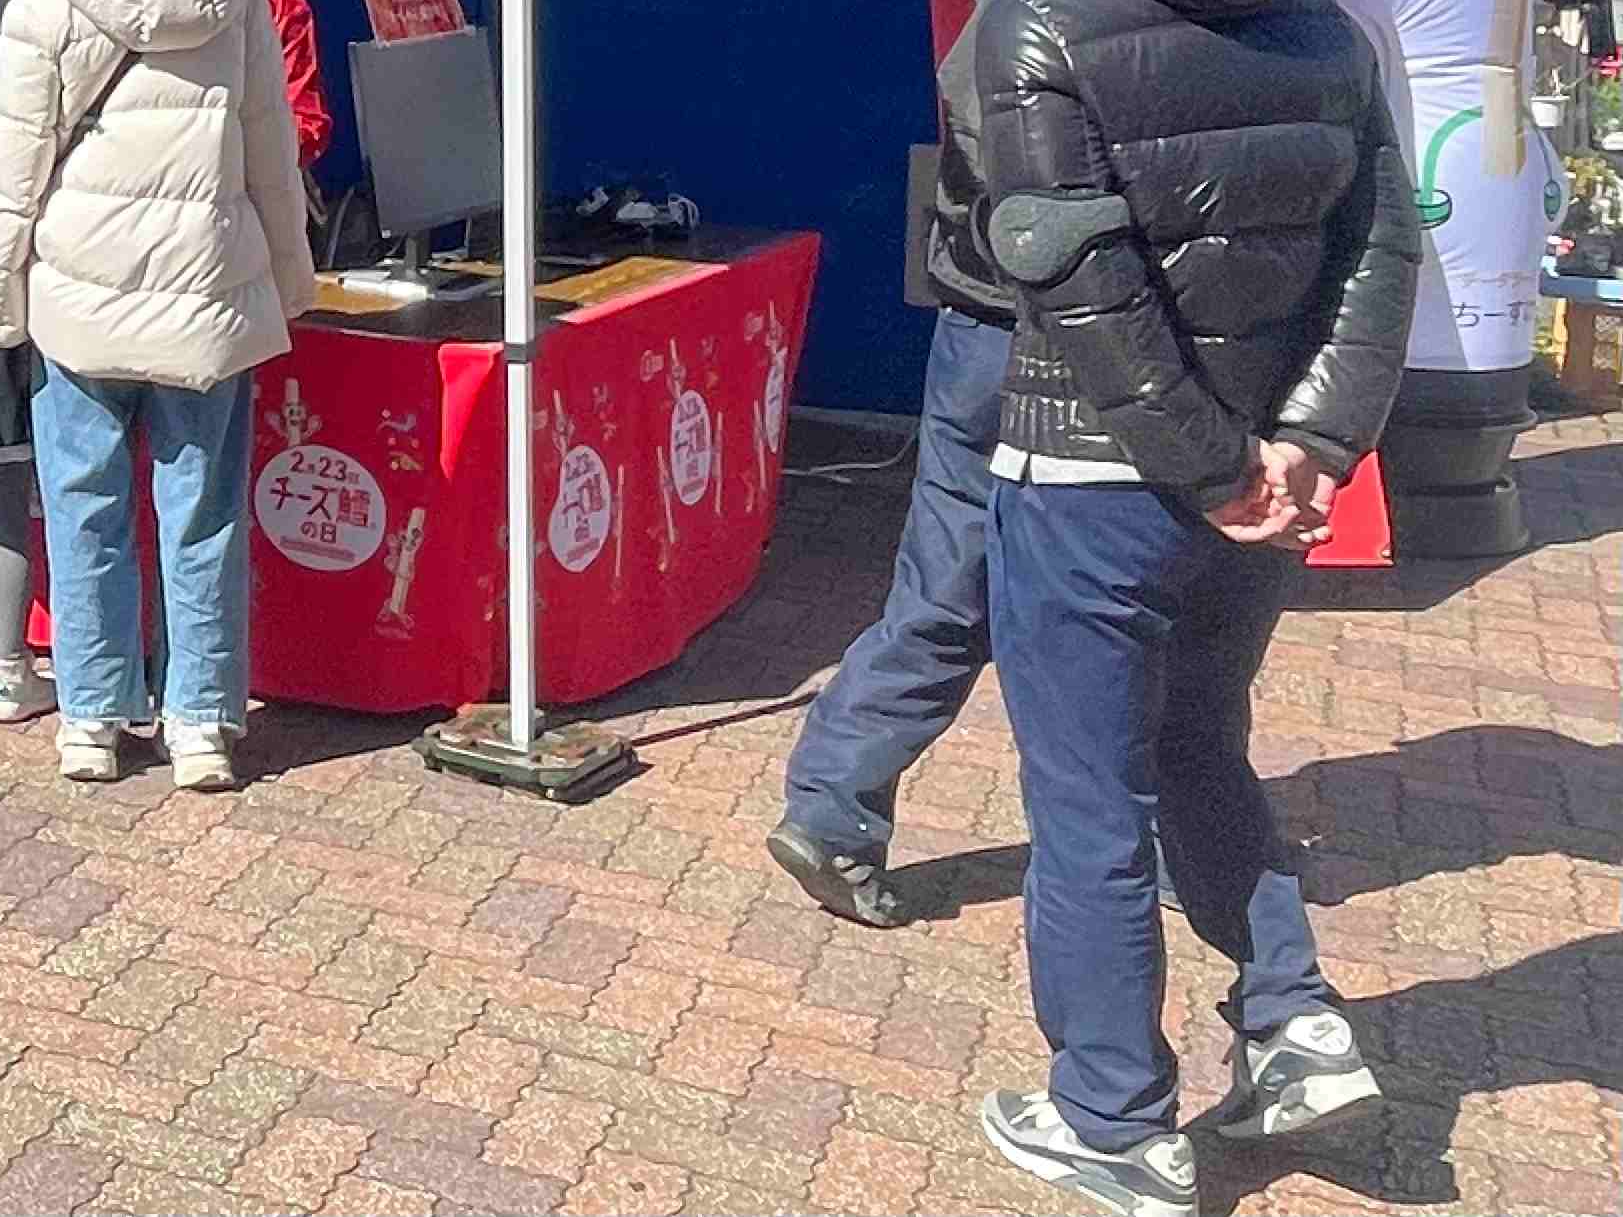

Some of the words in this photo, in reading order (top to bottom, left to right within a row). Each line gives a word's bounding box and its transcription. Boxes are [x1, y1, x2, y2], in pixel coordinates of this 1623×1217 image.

[269, 475, 371, 528] チーズ鱈
[300, 521, 337, 545] の日
